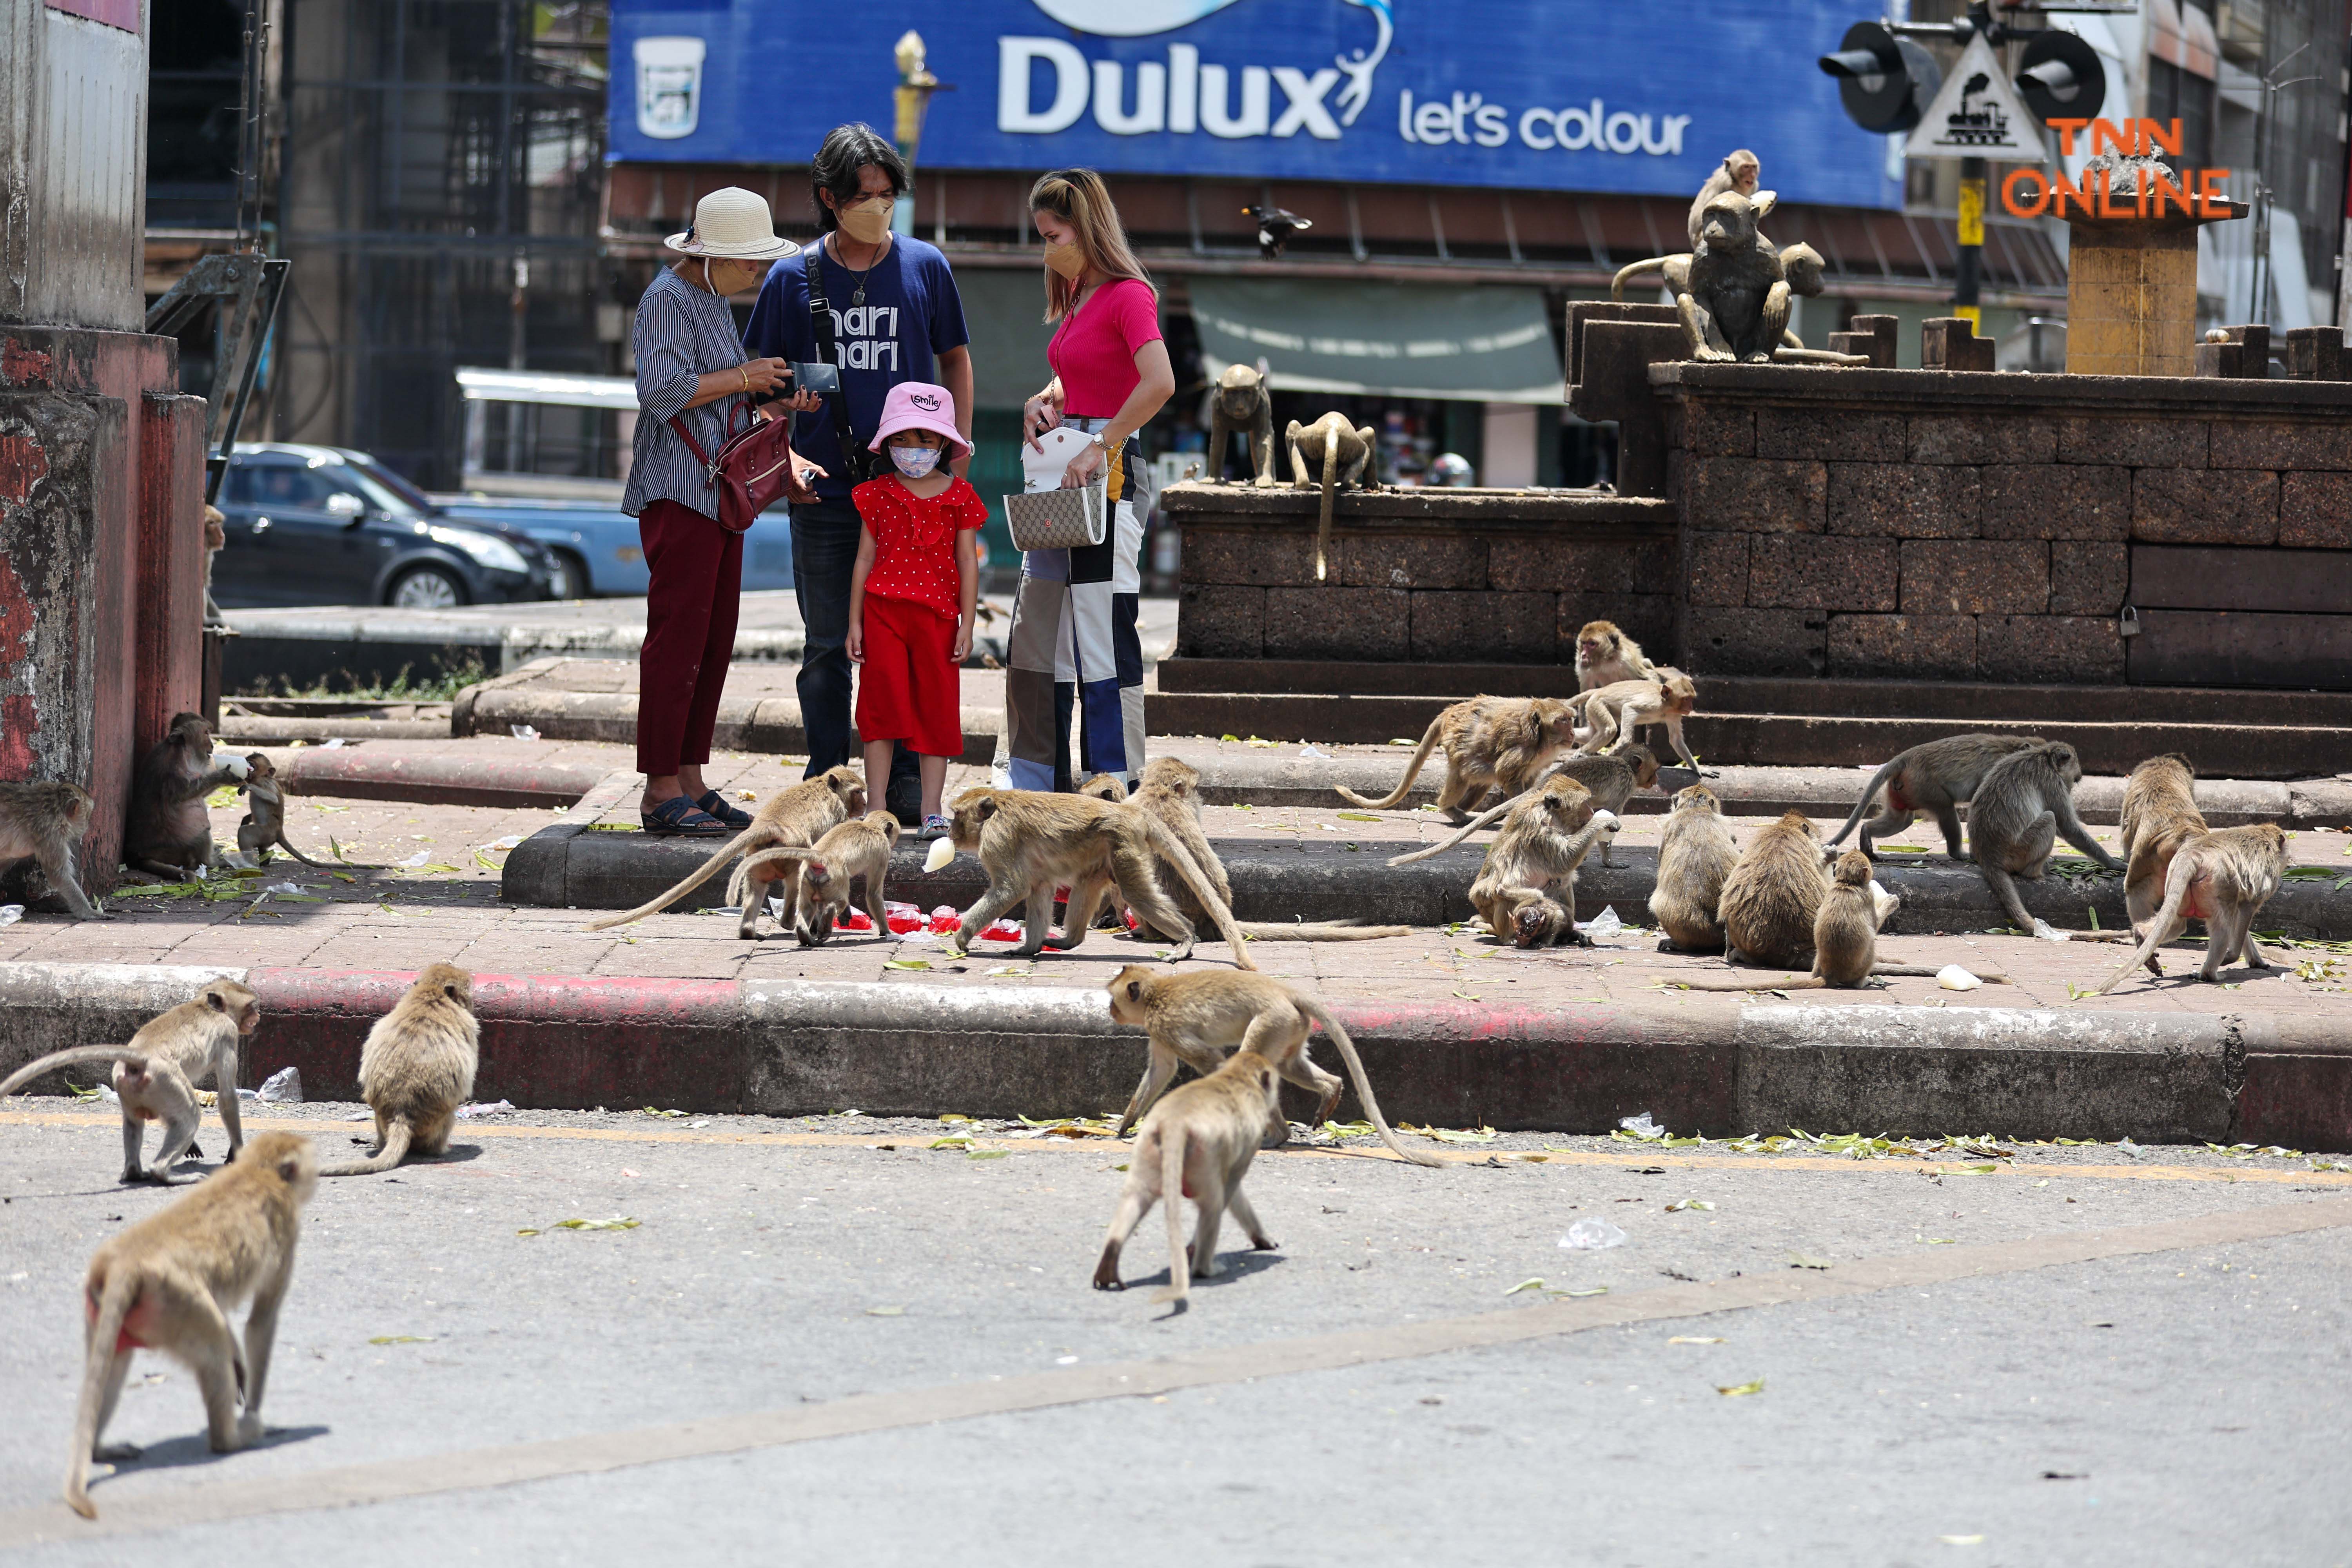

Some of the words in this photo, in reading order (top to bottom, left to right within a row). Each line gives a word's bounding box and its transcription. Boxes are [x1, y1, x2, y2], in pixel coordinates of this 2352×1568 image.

[998, 36, 1341, 139] Dulux
[1400, 90, 1509, 148] let's
[1519, 99, 1691, 155] colour
[808, 256, 822, 296] DEVY
